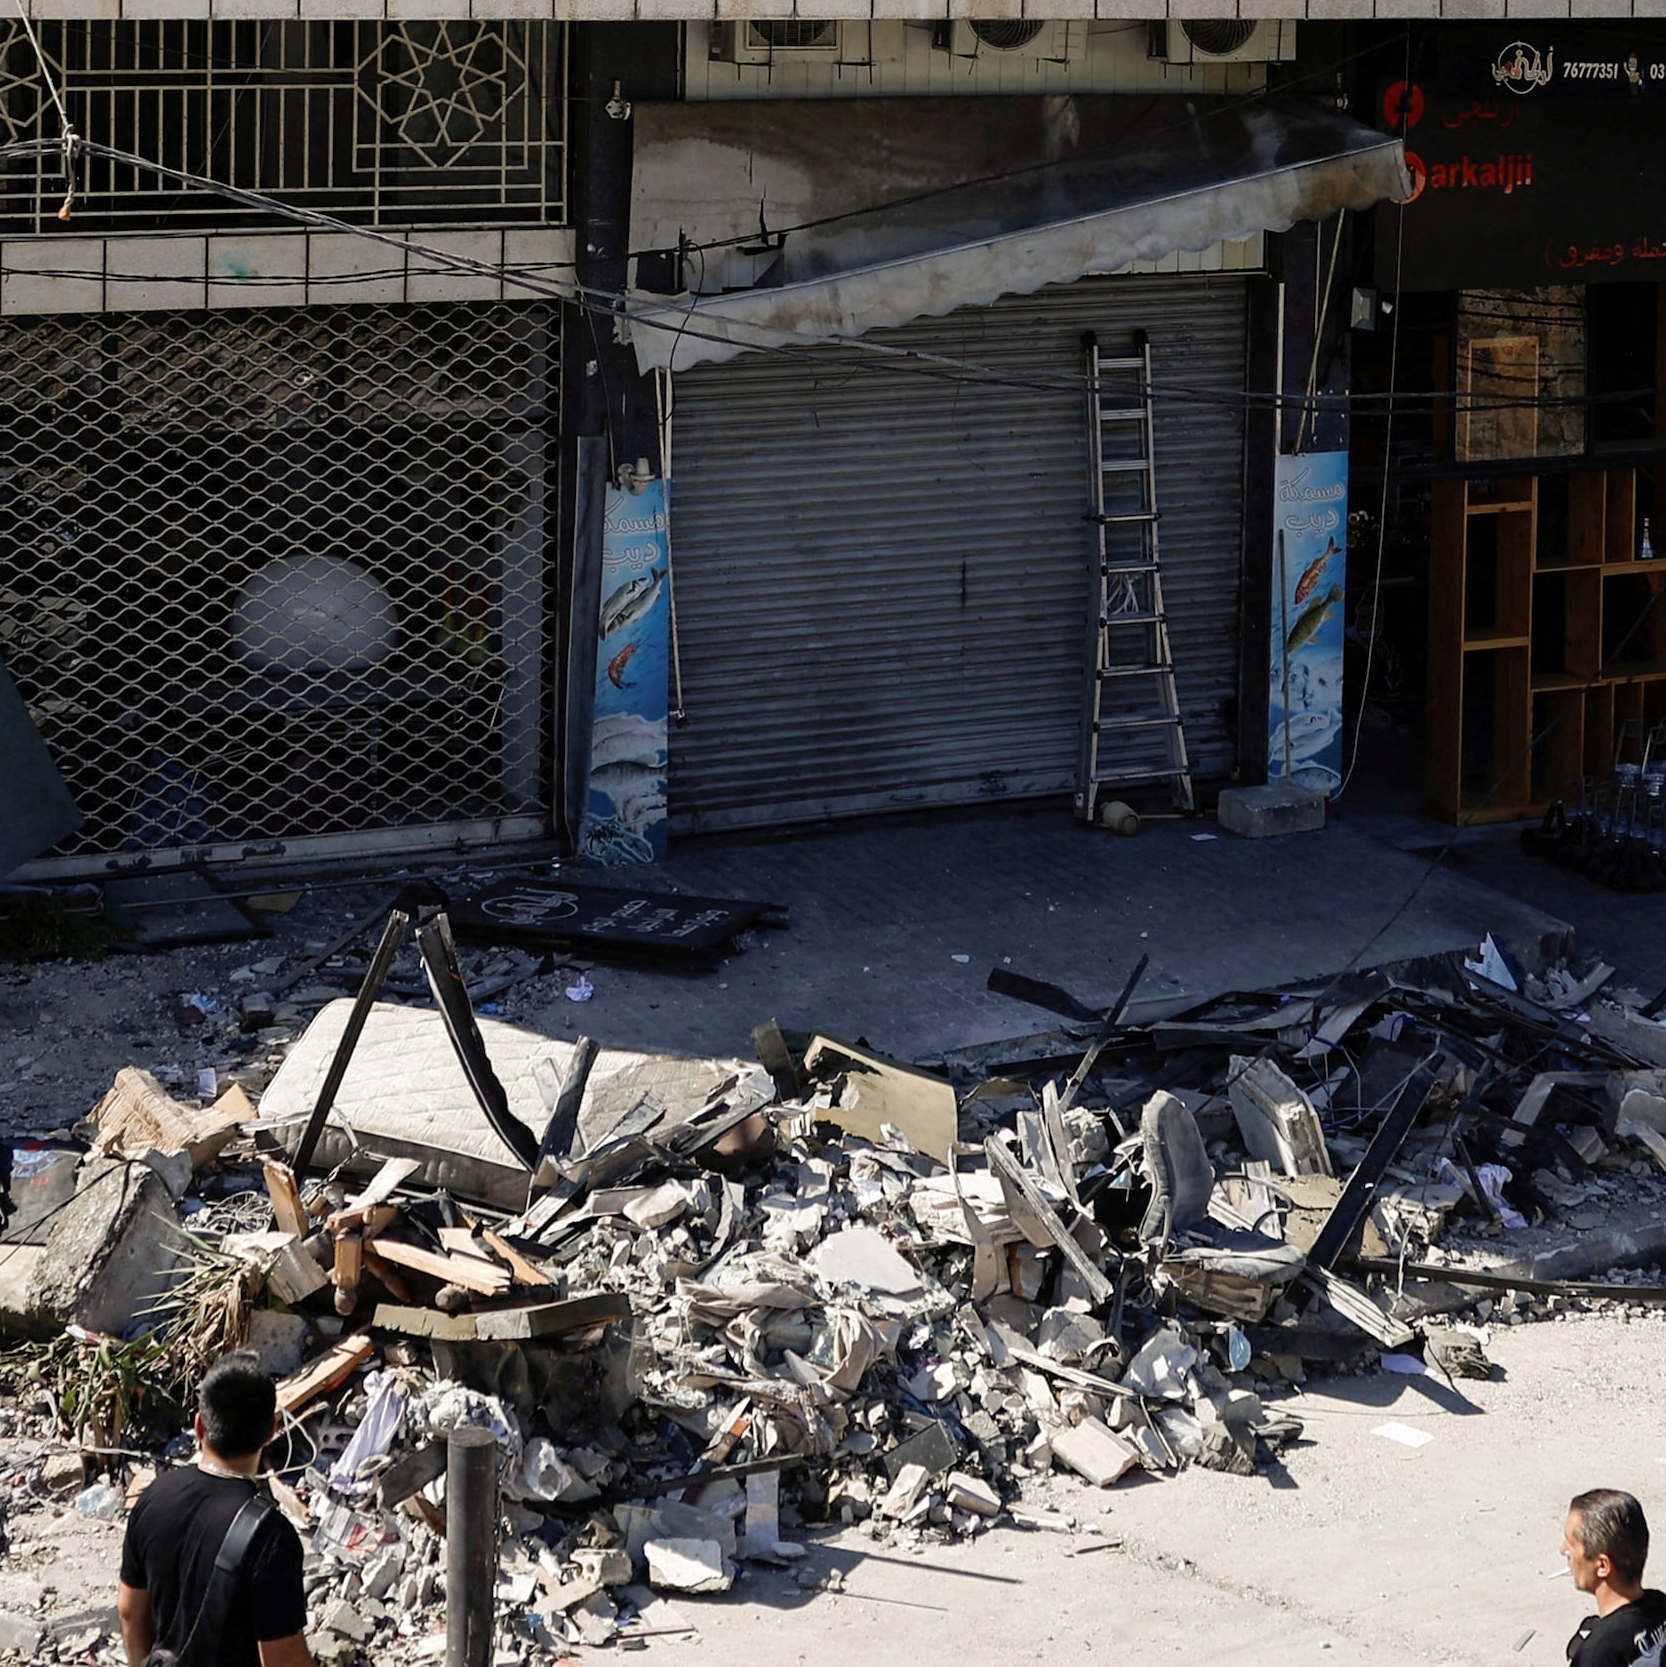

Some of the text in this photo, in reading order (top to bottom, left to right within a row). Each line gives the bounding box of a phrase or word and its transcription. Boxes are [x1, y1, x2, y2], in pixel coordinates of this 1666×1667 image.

[1562, 61, 1619, 80] 76777351
[1430, 153, 1534, 195] arkaljii
[1278, 466, 1345, 503] مسمكة
[603, 495, 666, 535] مسمك
[1284, 509, 1340, 538] ديب
